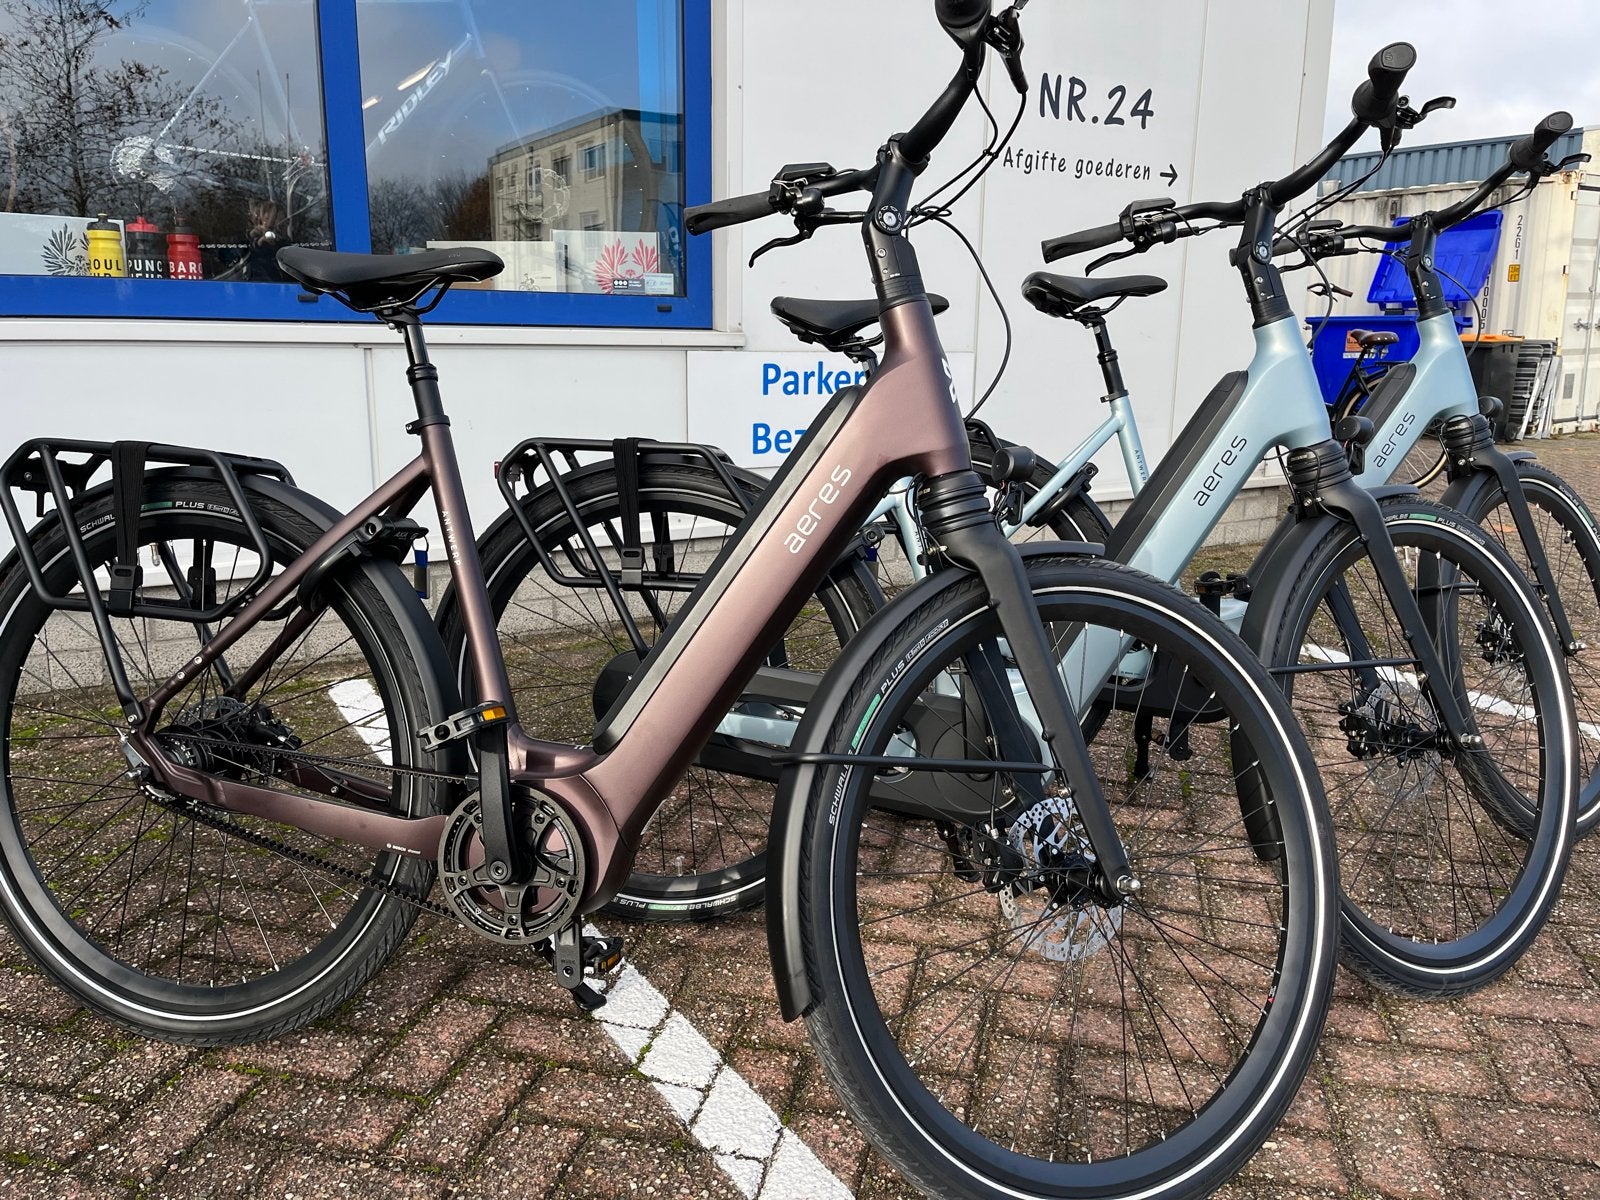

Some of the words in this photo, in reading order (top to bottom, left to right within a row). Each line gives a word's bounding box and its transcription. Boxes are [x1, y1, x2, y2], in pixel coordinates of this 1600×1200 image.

[378, 49, 452, 145] RIDLEY
[1039, 72, 1155, 130] NR.24
[1002, 146, 1067, 174] Afgifte
[1074, 158, 1151, 180] goederen
[1514, 215, 1524, 260] 22G1
[1373, 411, 1416, 468] aeres
[1193, 435, 1248, 507] aeres
[175, 501, 205, 509] PLUS
[783, 464, 852, 554] aeres
[1437, 516, 1457, 528] PLUS
[442, 510, 462, 566] ANTWERP
[880, 660, 905, 694] PLUS
[619, 900, 646, 909] PLUS
